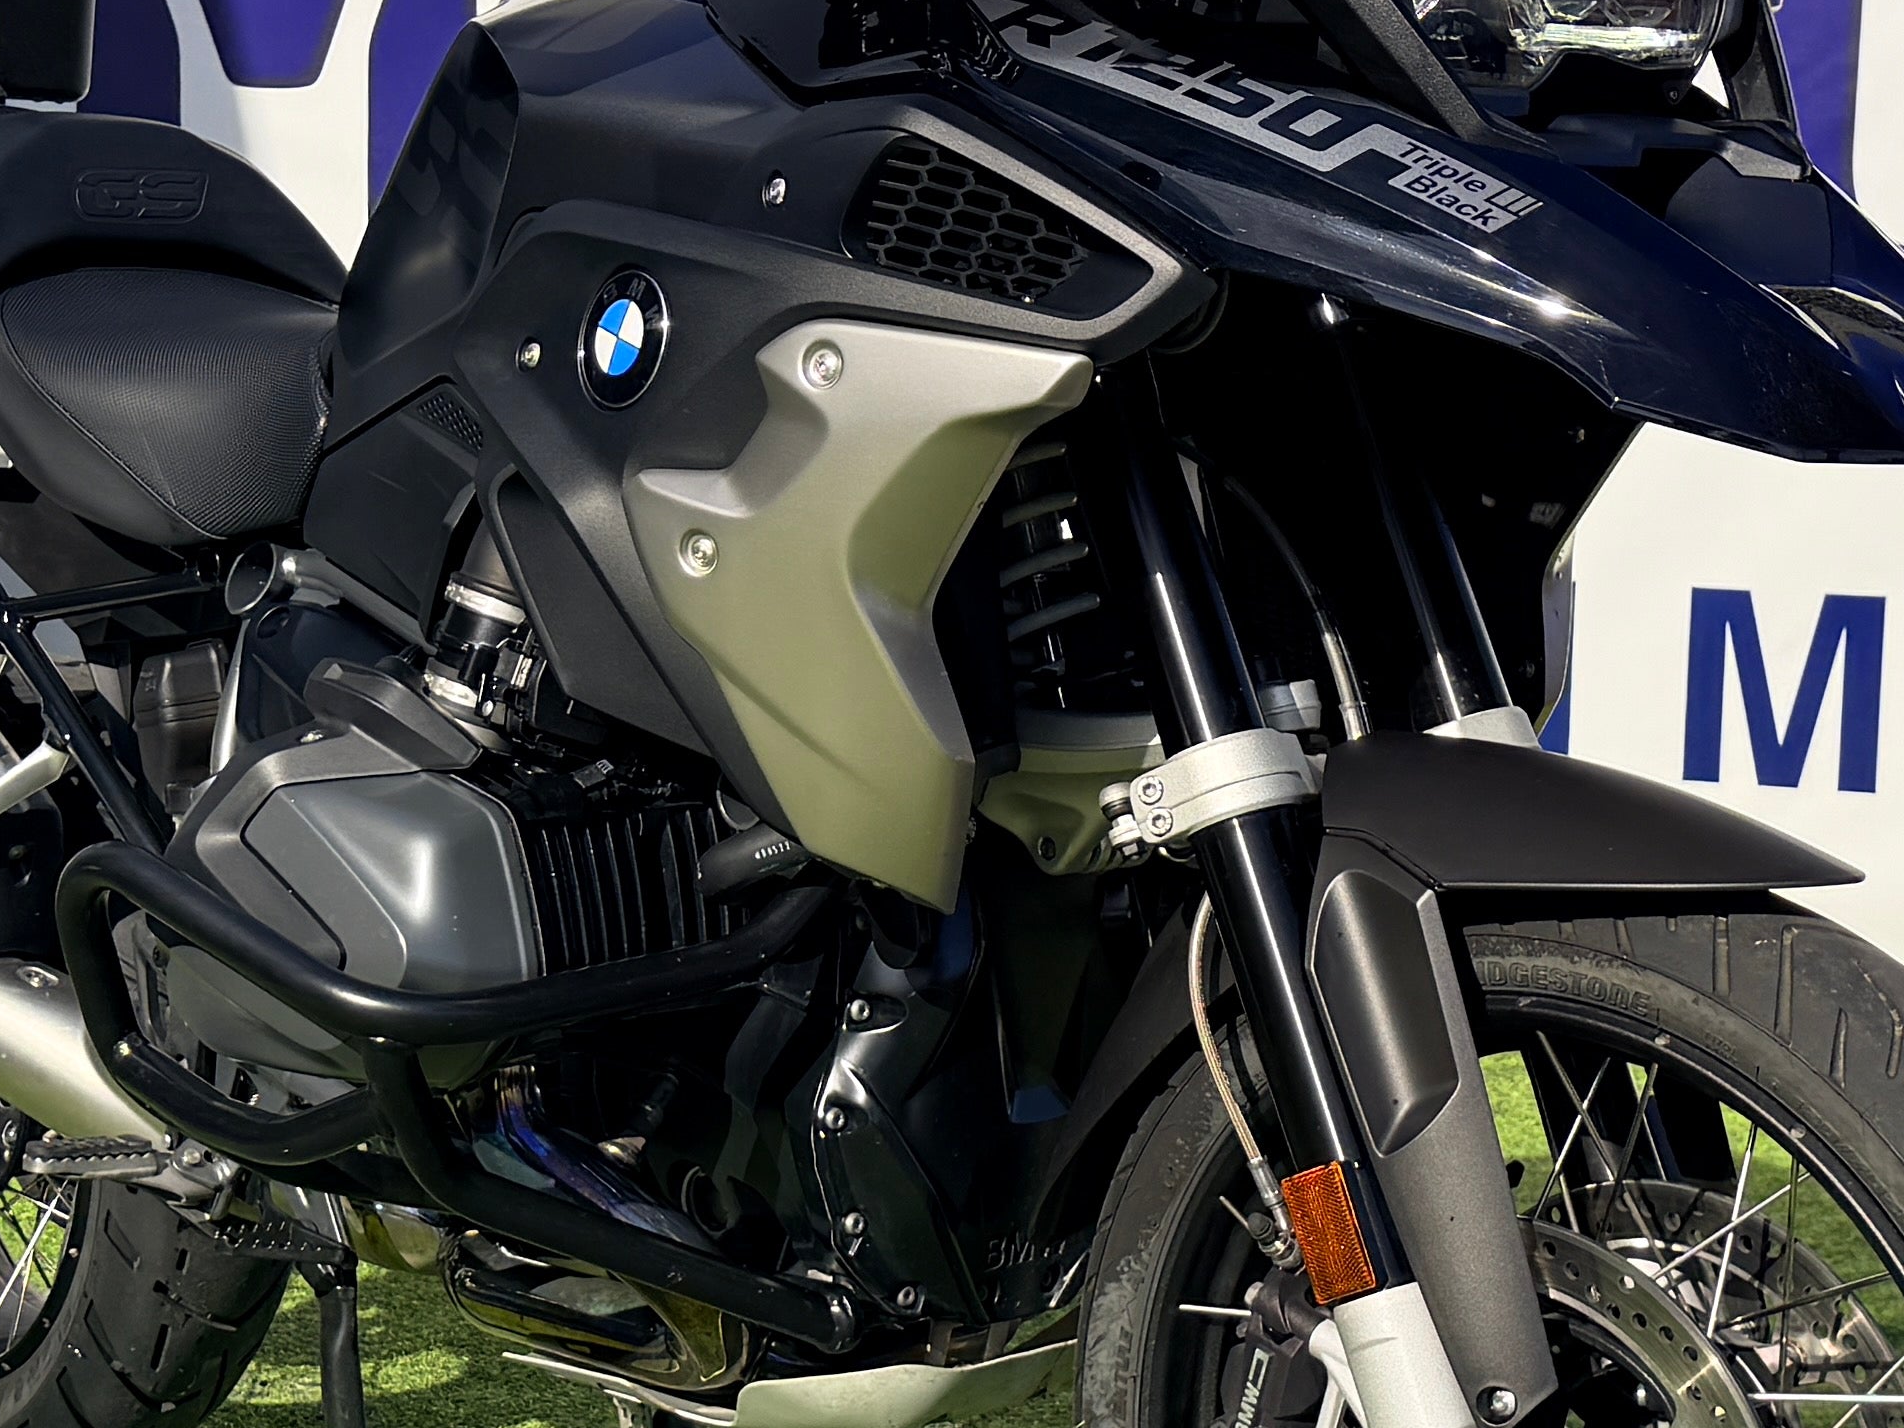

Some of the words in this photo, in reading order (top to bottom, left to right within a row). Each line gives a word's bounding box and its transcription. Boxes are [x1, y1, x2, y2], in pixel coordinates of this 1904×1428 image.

[1399, 140, 1488, 194] Triple
[1404, 172, 1503, 227] Black
[602, 277, 662, 331] BMW
[1476, 958, 1652, 1018] IDGESTONE
